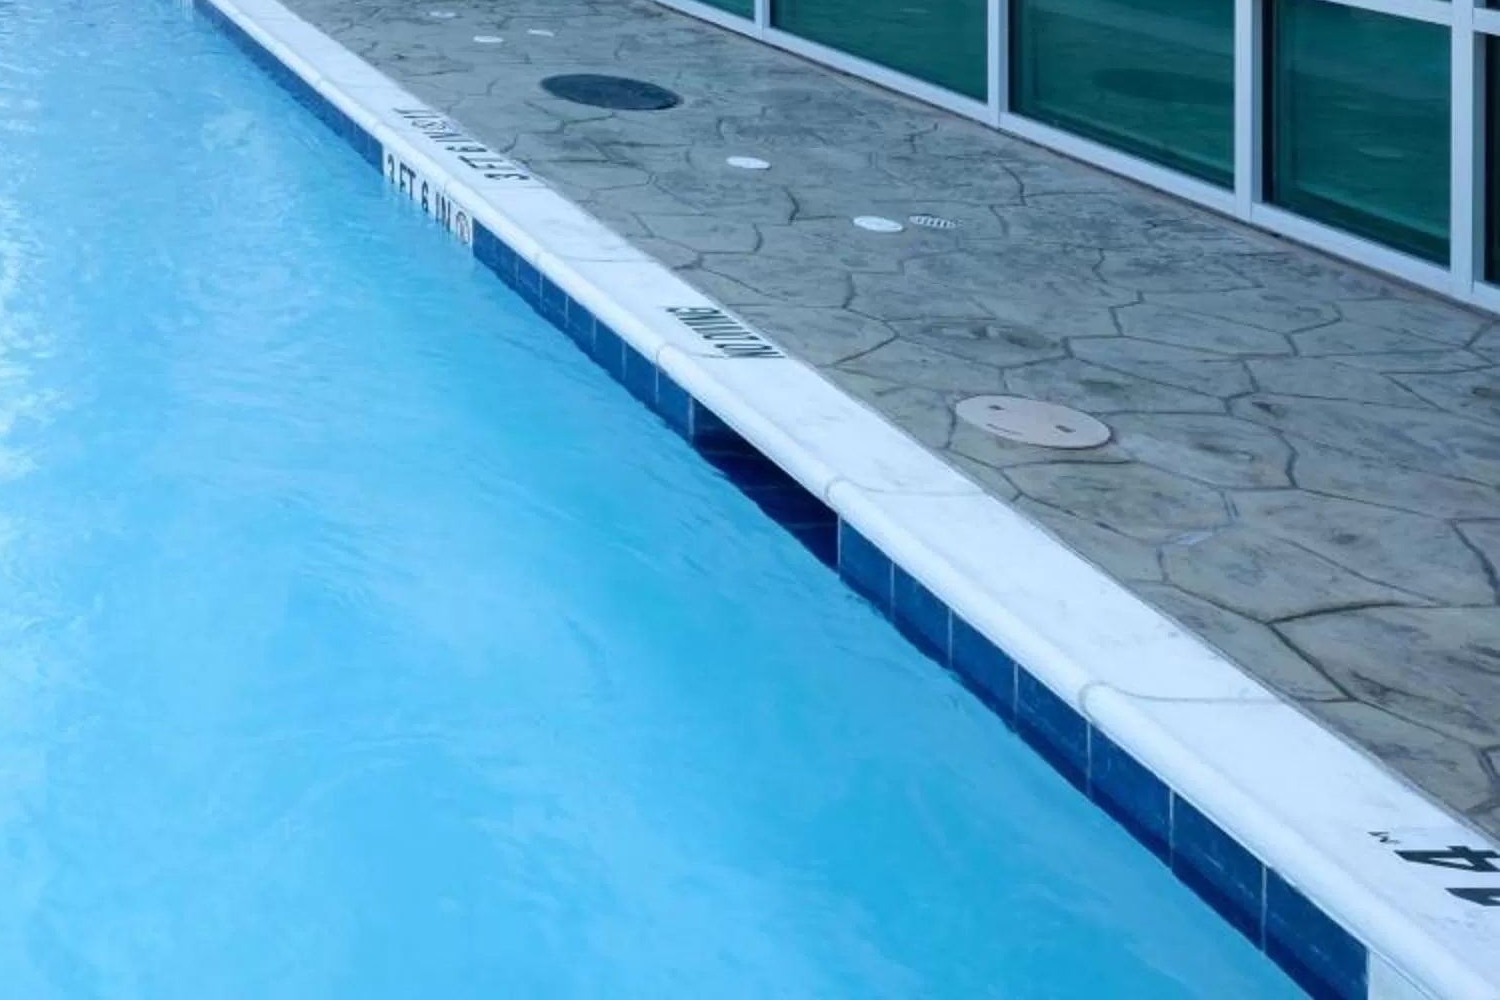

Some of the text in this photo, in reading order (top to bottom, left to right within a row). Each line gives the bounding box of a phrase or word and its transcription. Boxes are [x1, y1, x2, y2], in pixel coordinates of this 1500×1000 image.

[399, 161, 417, 201] FT
[435, 191, 452, 233] IN
[665, 306, 788, 360] NO DIVING
